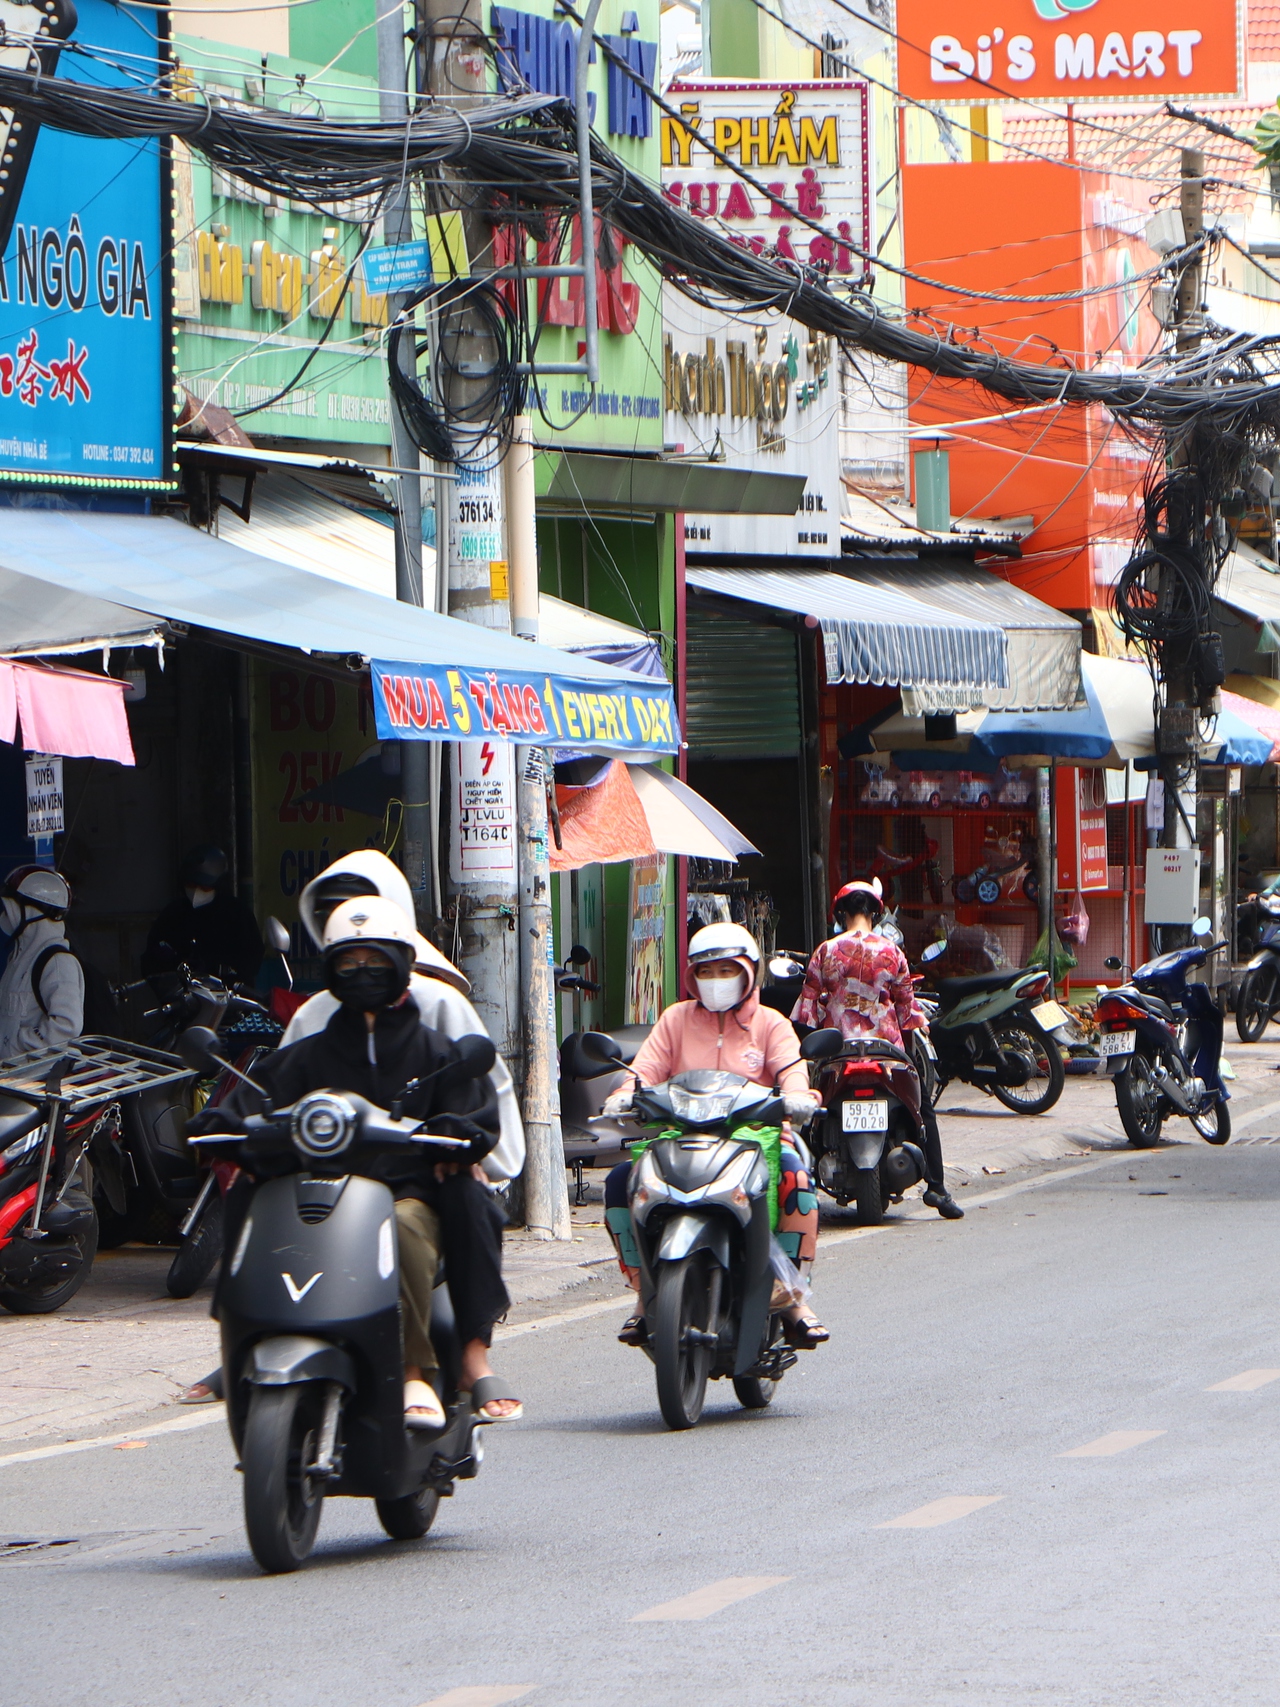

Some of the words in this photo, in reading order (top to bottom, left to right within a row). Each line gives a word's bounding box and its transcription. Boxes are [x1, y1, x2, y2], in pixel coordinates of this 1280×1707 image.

[1054, 29, 1202, 79] MART
[602, 11, 658, 138] TÂY
[713, 90, 841, 165] PHẨM
[17, 213, 88, 313] NGÔ
[97, 236, 151, 319] GIA
[22, 438, 38, 459] NHÀ
[381, 674, 449, 729] MUA
[446, 670, 471, 735] 5
[469, 671, 548, 739] TẶNG
[543, 676, 564, 739] 1
[561, 690, 633, 740] EVERY
[631, 696, 674, 744] DAY
[278, 751, 345, 823] 25K
[463, 809, 469, 822] J
[477, 810, 504, 820] LVLU
[463, 827, 508, 841] T164C
[1106, 1032, 1130, 1044] 59-Z1
[845, 1116, 885, 1129] 470.28
[849, 1103, 879, 1116] 59-Z1
